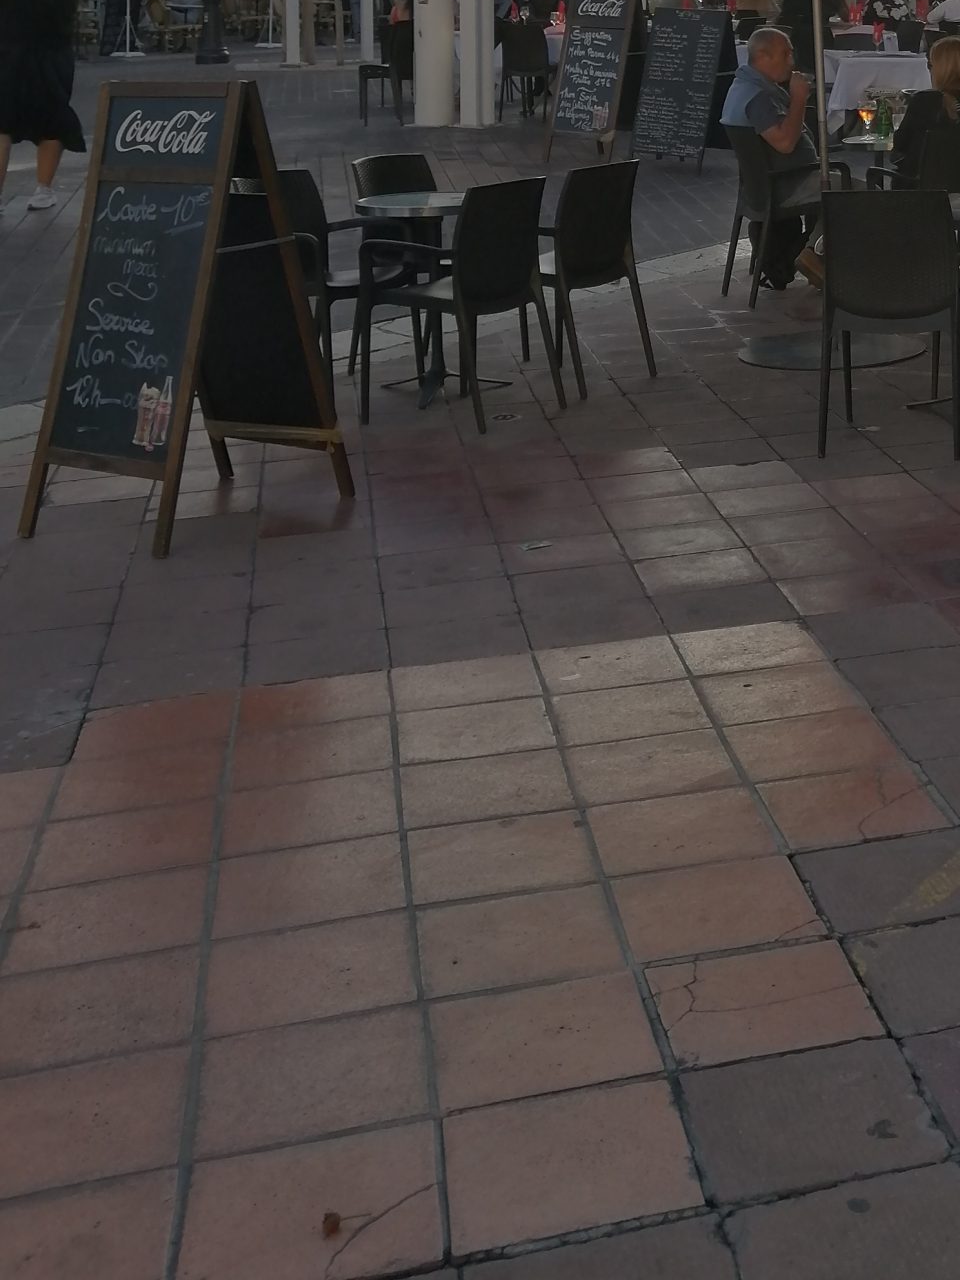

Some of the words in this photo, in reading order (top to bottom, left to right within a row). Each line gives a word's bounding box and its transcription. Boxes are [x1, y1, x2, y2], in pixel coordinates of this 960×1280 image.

[114, 109, 217, 155] Coca-Cola
[86, 297, 154, 335] Service
[75, 334, 115, 369] Non
[121, 340, 168, 374] Stop
